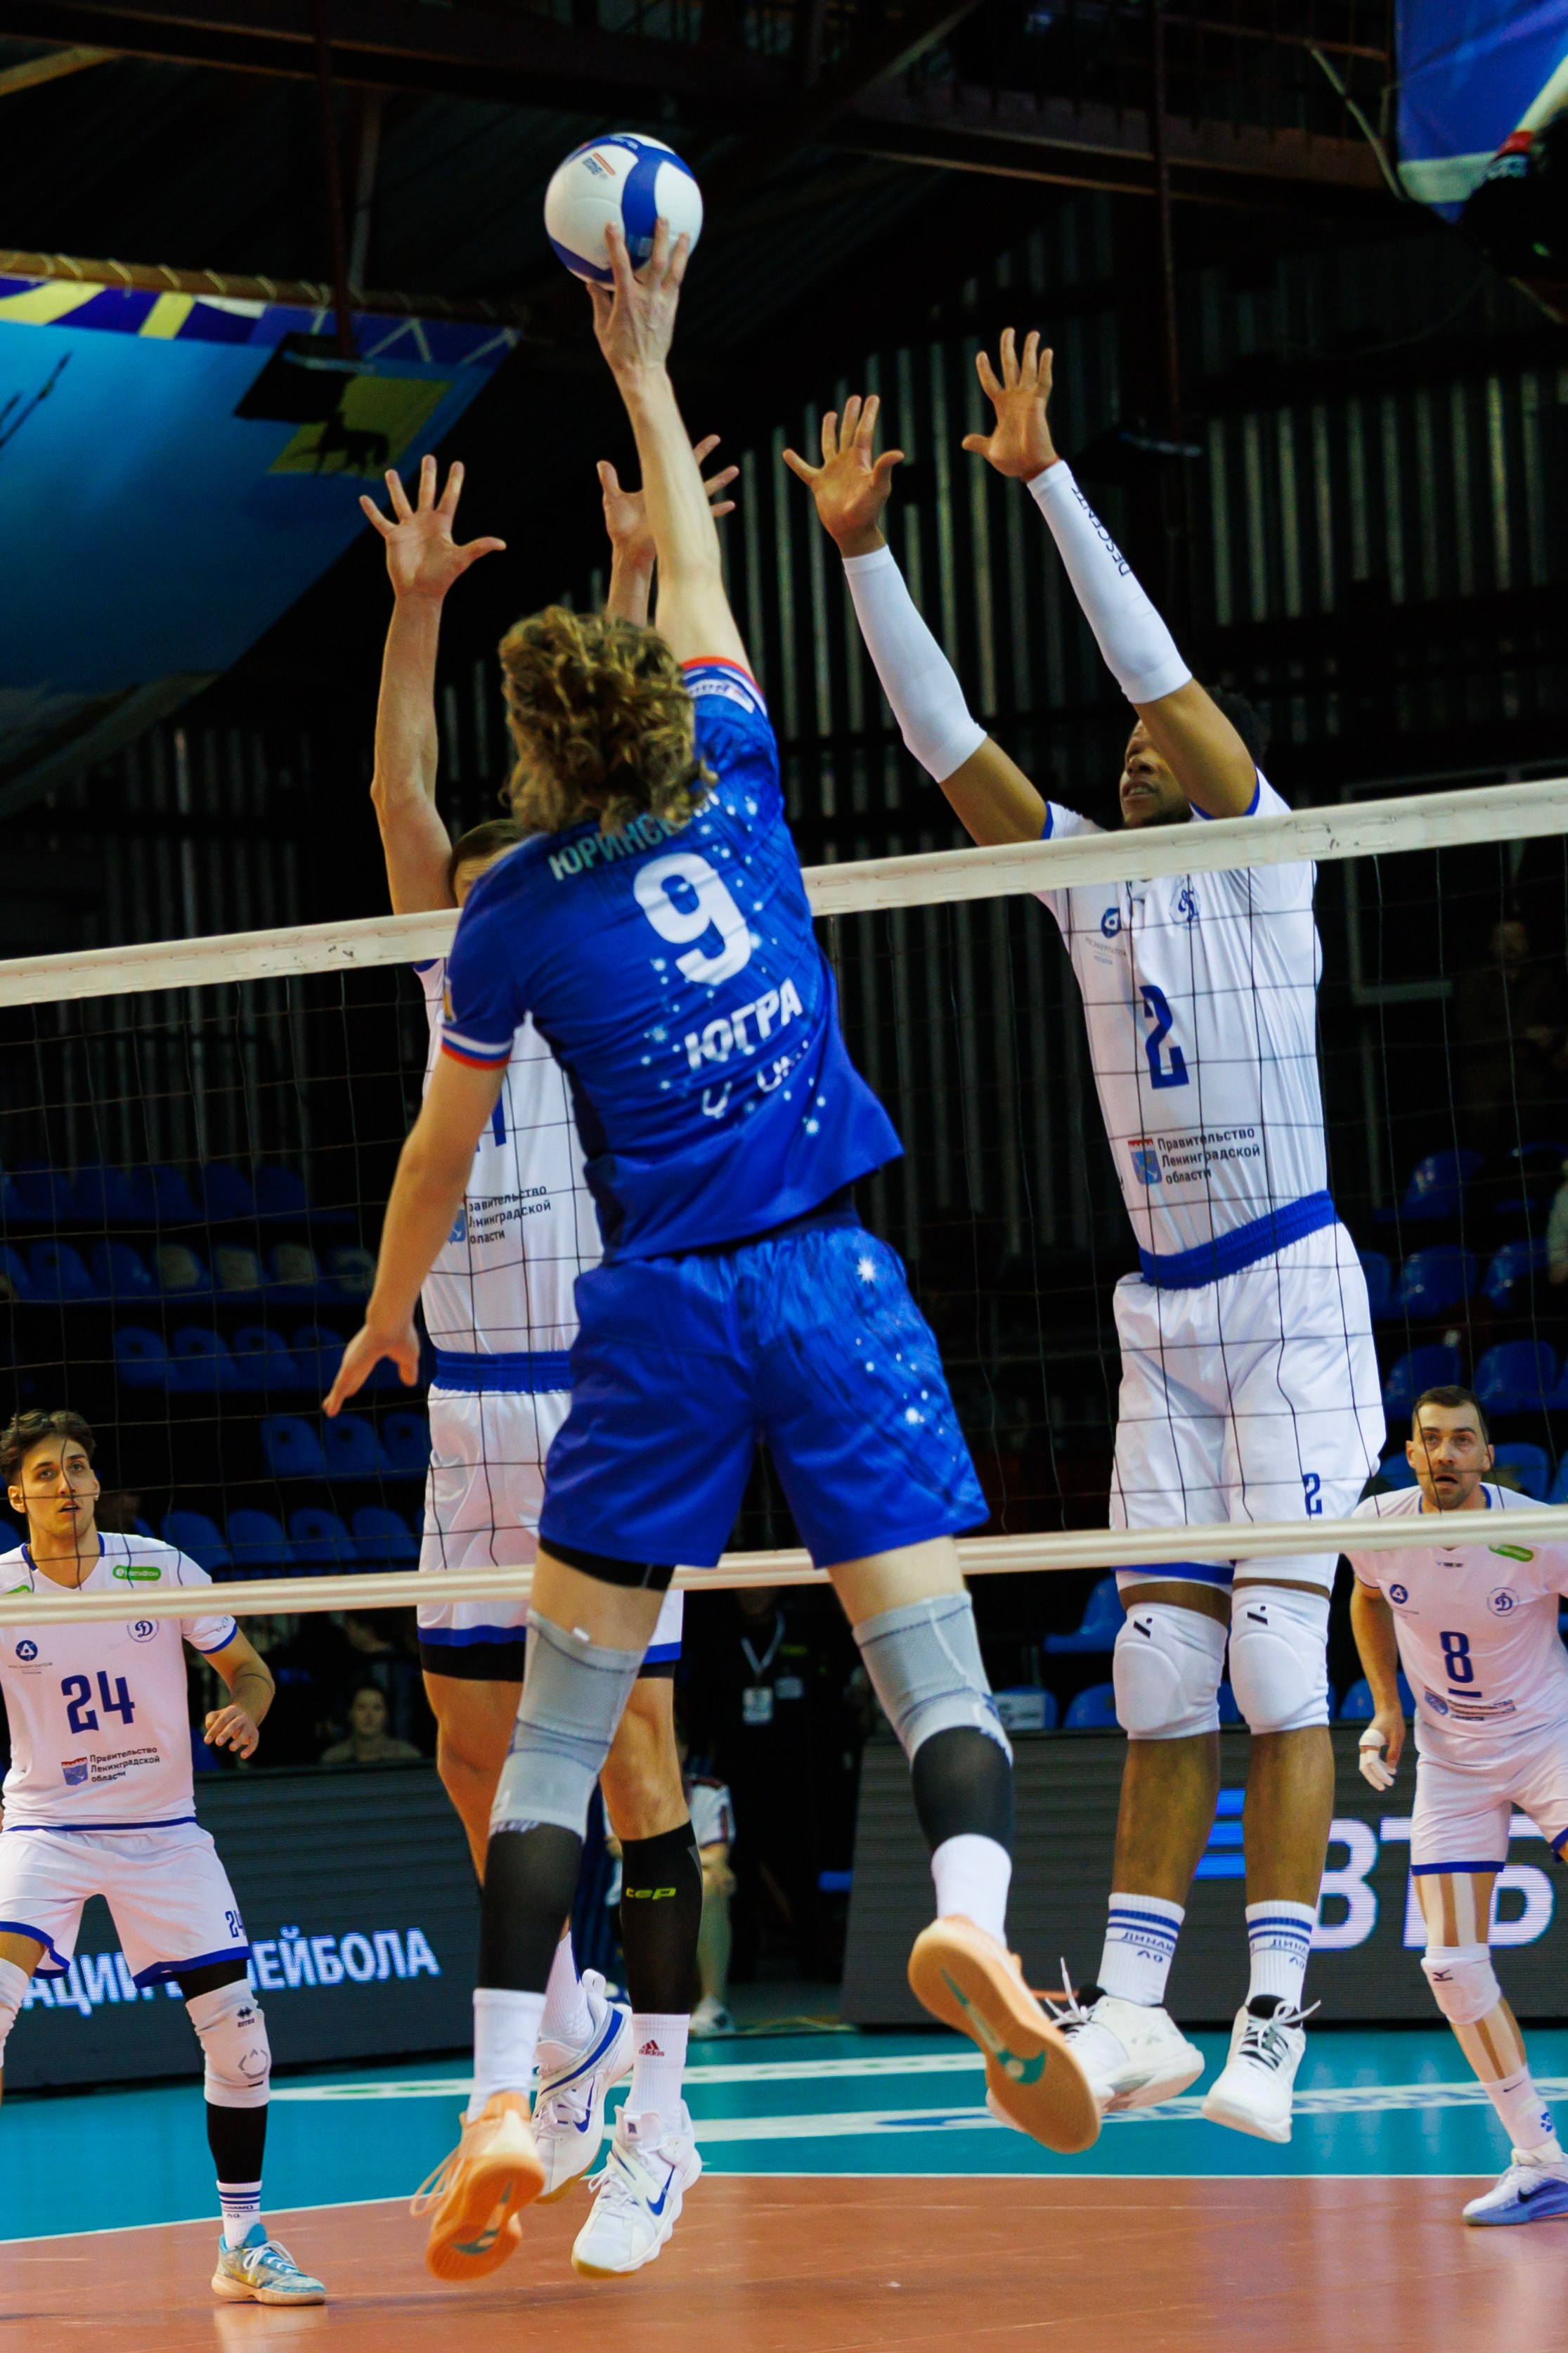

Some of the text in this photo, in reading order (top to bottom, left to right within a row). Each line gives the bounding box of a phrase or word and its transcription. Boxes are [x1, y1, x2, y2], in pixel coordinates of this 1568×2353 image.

[633, 852, 751, 985] 9
[684, 977, 803, 1071] ЮГРА
[1139, 985, 1189, 1090] 2
[1162, 1143, 1260, 1168] Ленинградской
[1165, 1169, 1212, 1185] области
[469, 1230, 505, 1244] оласти
[1302, 1473, 1323, 1515] 2
[1439, 1631, 1475, 1684] 8
[60, 1670, 135, 1734] 24
[89, 1747, 158, 1764] Правительство
[91, 1755, 161, 1773] Ленинградской
